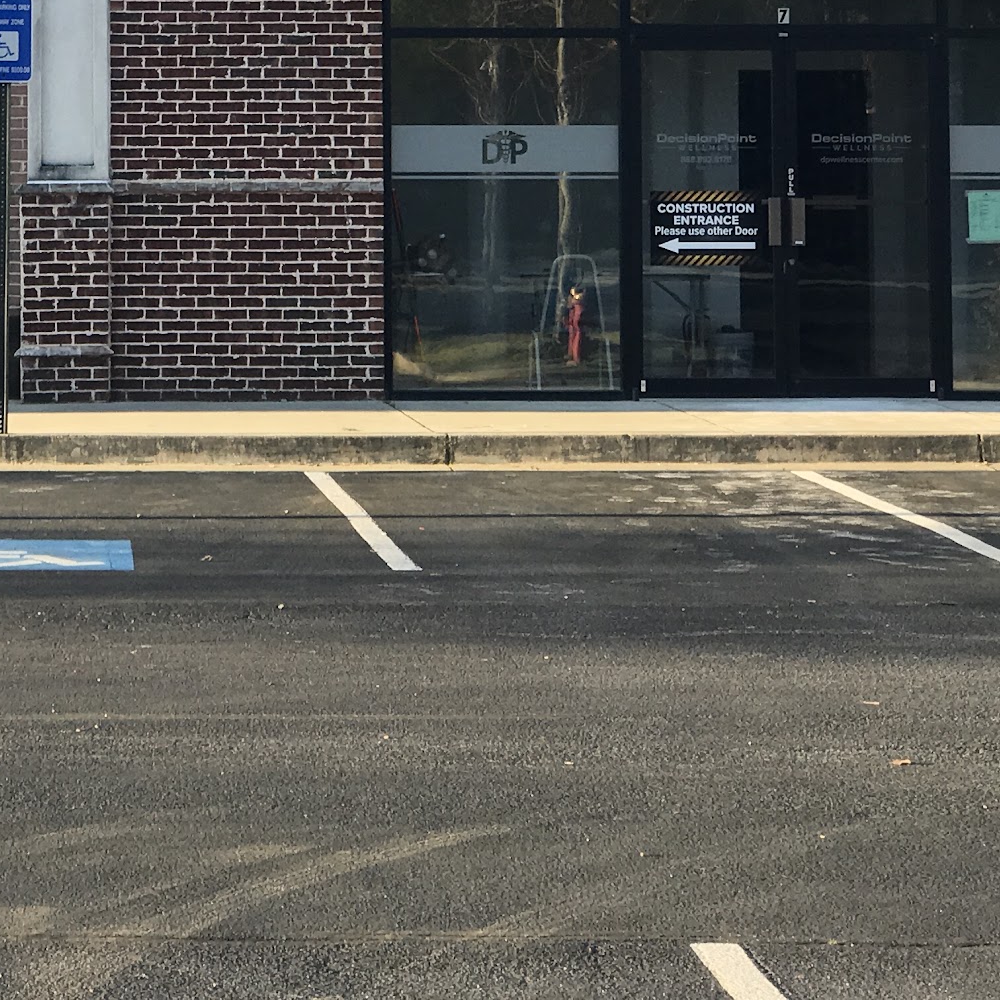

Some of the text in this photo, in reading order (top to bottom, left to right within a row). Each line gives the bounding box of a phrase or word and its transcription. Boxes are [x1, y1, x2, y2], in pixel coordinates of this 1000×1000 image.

[779, 9, 788, 23] 7
[656, 132, 758, 144] DecisionPoint
[811, 133, 912, 144] DecisionPoint
[678, 144, 738, 152] WELLNESS
[832, 144, 894, 152] WELLNESS
[787, 167, 795, 193] PULL
[657, 203, 755, 214] CONSTRUCTION
[673, 215, 740, 226] ENTRANCE
[654, 226, 759, 236] Please use other Door
